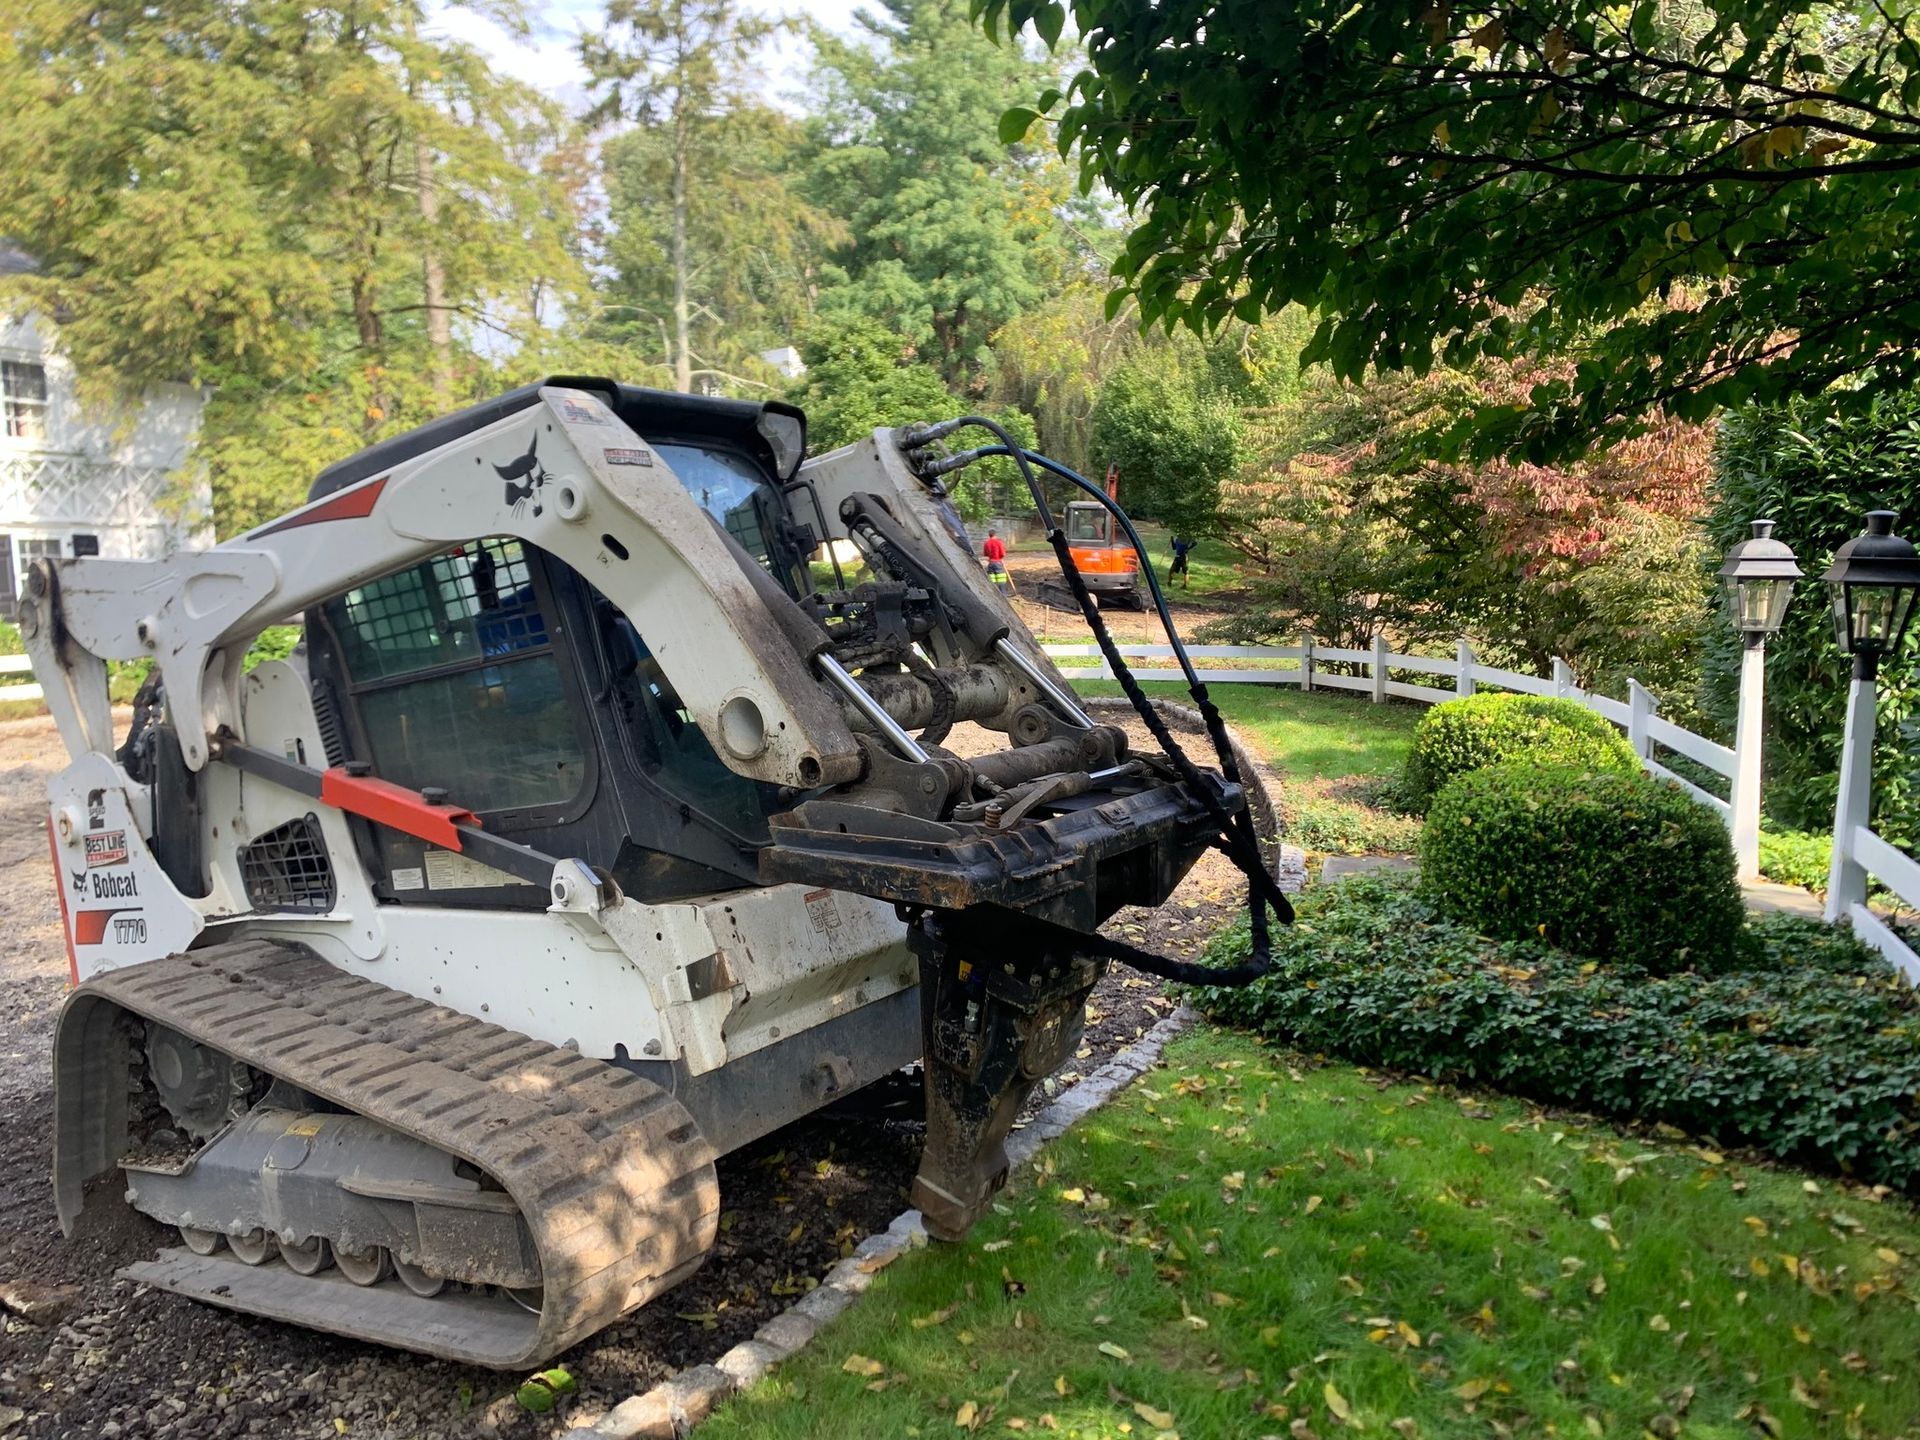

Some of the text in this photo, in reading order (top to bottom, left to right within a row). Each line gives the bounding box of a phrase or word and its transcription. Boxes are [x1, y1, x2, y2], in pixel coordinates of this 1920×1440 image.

[85, 832, 125, 853] BEST LINE
[92, 871, 138, 898] Bobcat
[113, 918, 147, 944] T770
